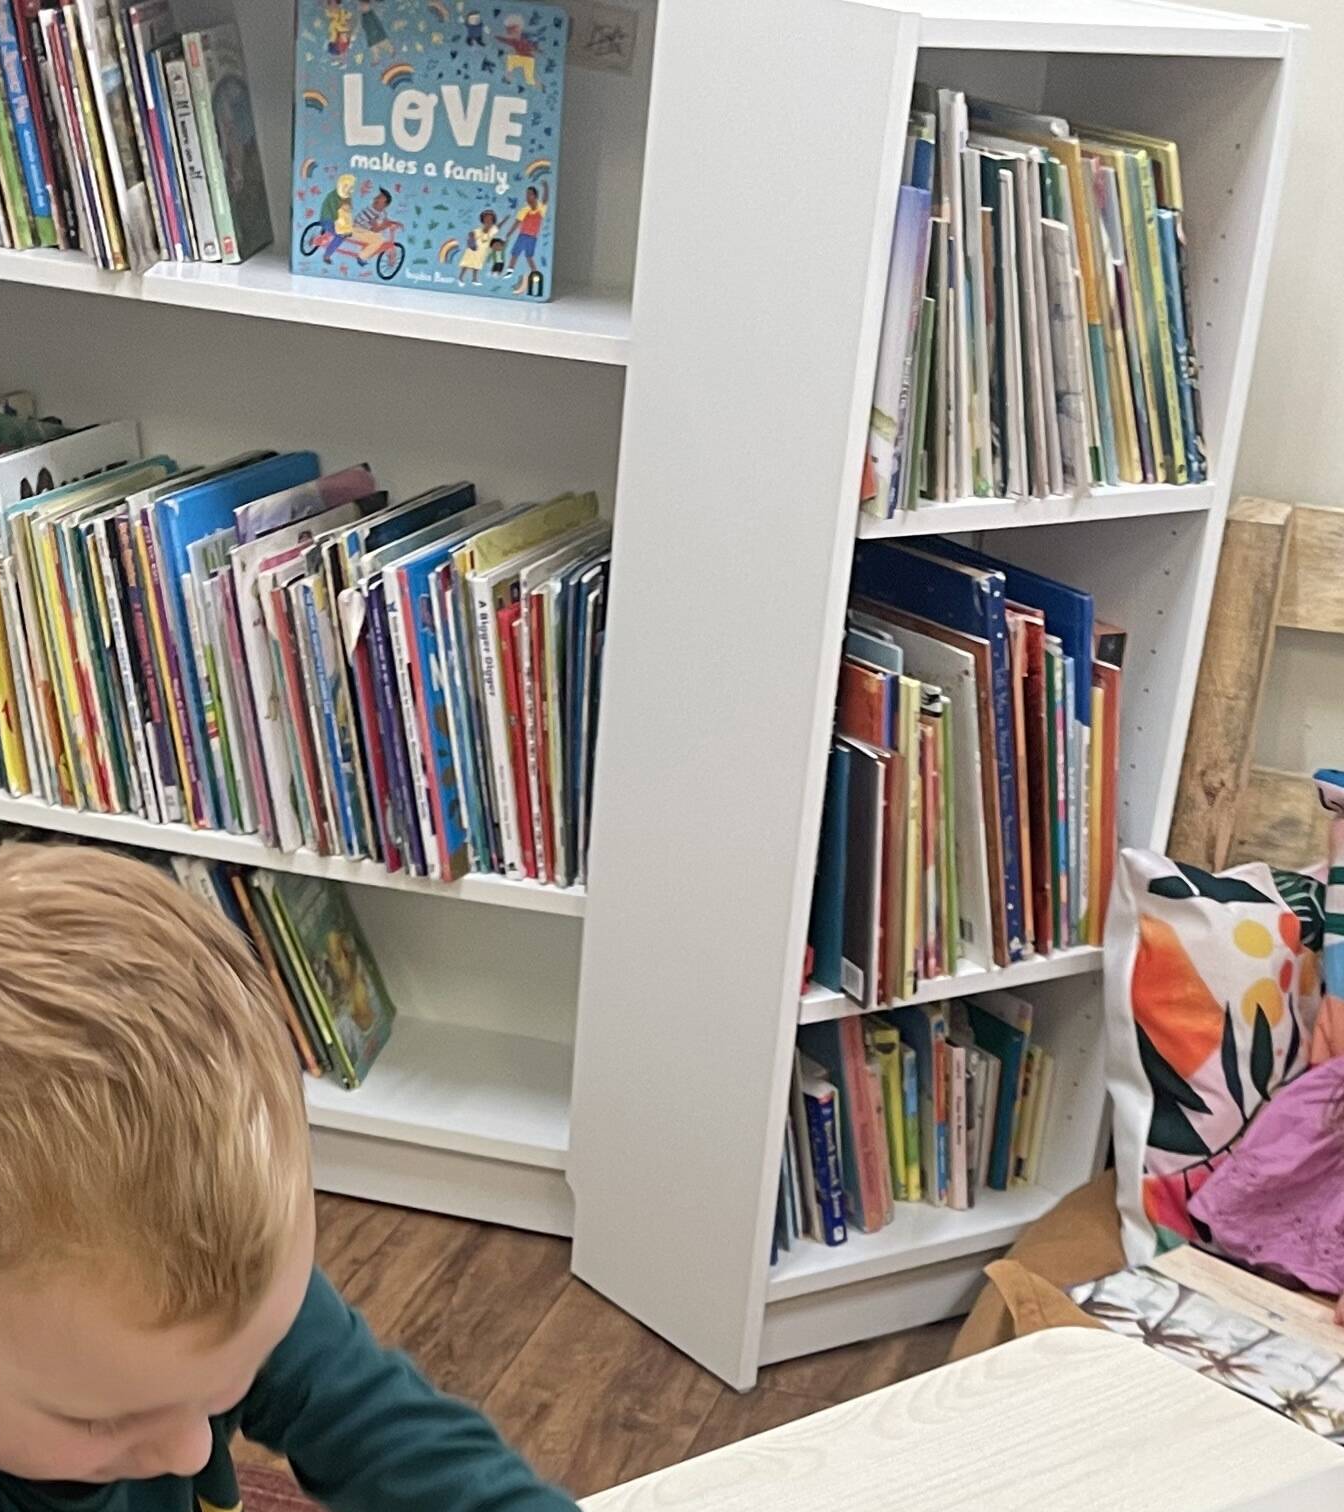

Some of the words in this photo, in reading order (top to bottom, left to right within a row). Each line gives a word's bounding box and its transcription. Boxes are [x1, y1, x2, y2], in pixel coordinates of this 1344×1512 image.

[343, 73, 528, 162] LOVE
[350, 152, 418, 175] makes
[424, 163, 437, 177] a
[444, 160, 510, 195] family
[478, 600, 487, 609] A
[479, 613, 490, 652] Bigger
[484, 657, 495, 696] Digger
